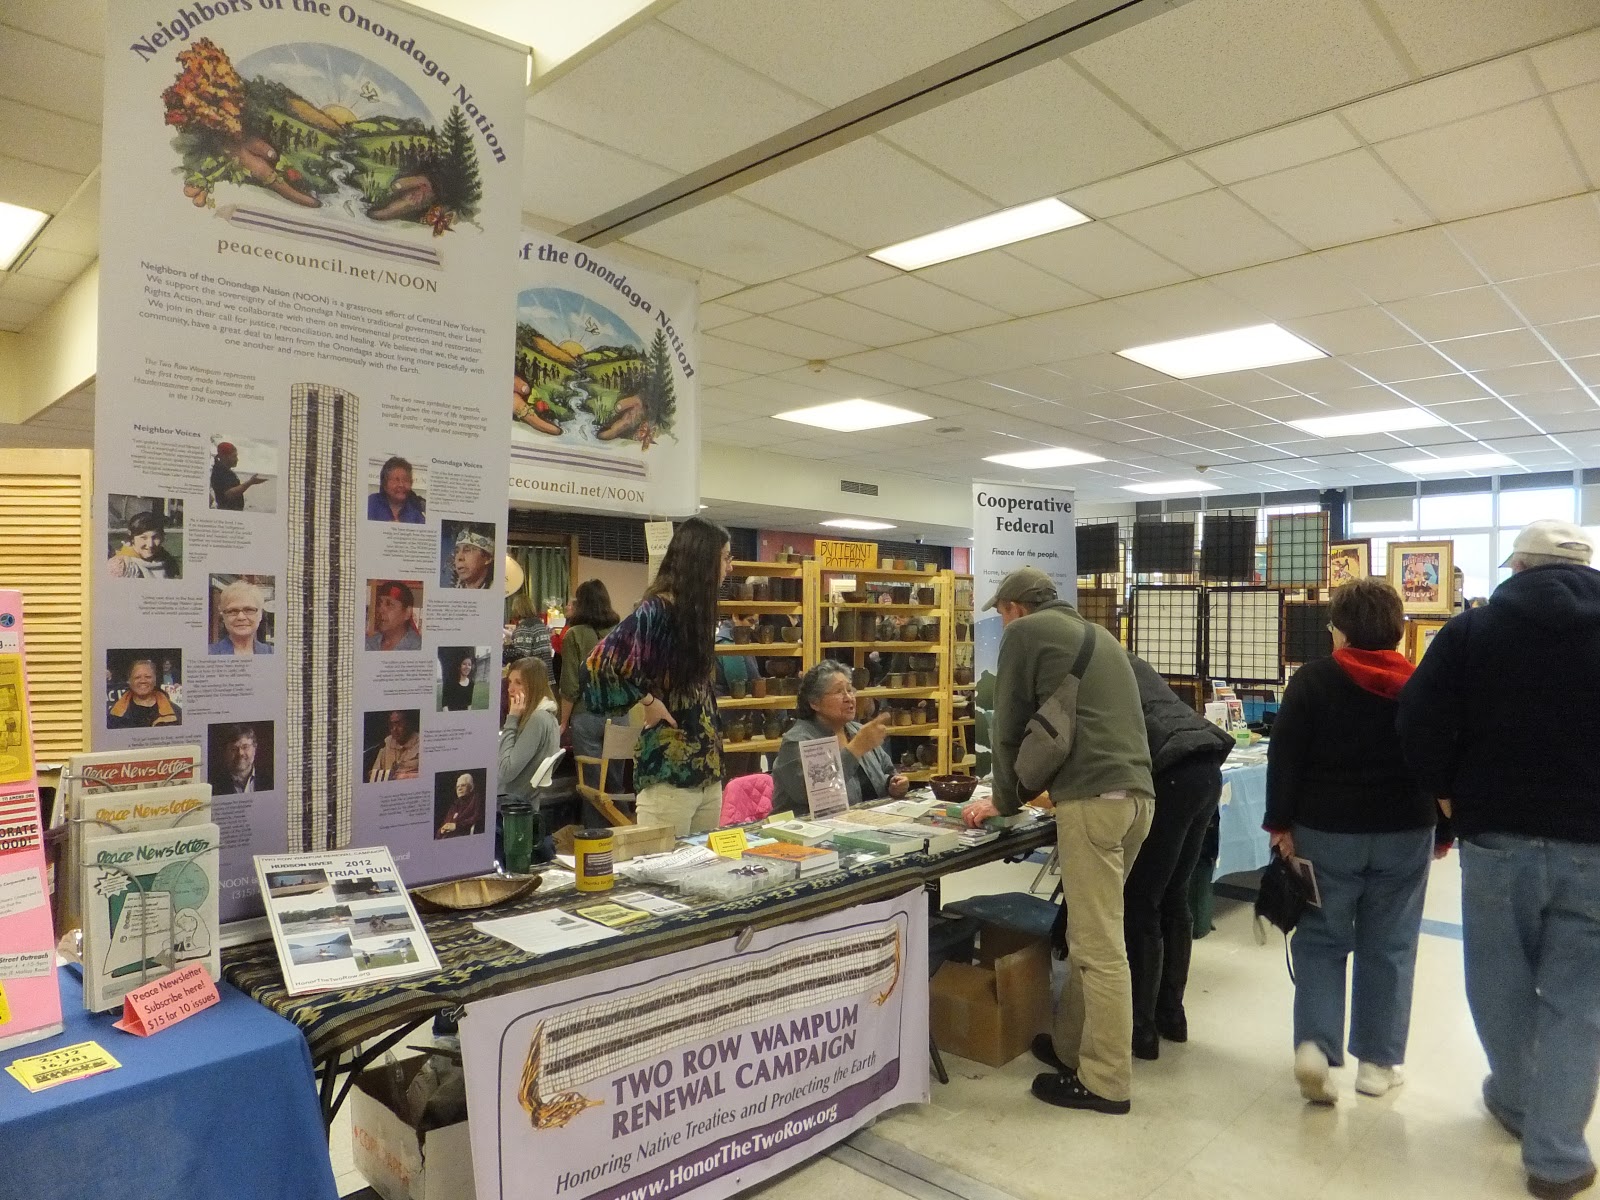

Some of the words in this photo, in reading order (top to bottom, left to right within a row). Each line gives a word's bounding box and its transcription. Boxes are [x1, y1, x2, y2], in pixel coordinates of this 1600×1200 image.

[130, 0, 253, 62] Neighbors
[339, 5, 450, 86] Onondaga
[453, 84, 506, 163] Nation
[217, 239, 437, 293] peacecouncil.net/NOON
[141, 261, 187, 278] Neighbors
[190, 272, 199, 280] of
[201, 275, 215, 284] the
[218, 277, 260, 293] Onondaga
[263, 285, 290, 298] Nation
[292, 291, 330, 305] (NOON)
[346, 302, 383, 316] grassroots
[385, 310, 405, 319] effort
[416, 315, 441, 326] Central
[443, 320, 459, 330] New
[461, 324, 487, 335] Yorkers.
[146, 274, 163, 285] We
[165, 280, 199, 293] support
[201, 286, 216, 295] the
[218, 291, 265, 305] sovereignty
[267, 299, 276, 307] of
[278, 301, 291, 309] the
[293, 303, 333, 318] Onondaga
[336, 310, 365, 322] Nation's
[367, 318, 404, 330] traditional
[405, 325, 447, 338] government,
[448, 331, 464, 340] their
[465, 335, 482, 344] Land
[538, 244, 569, 264] the
[574, 252, 652, 314] Onondaga
[655, 309, 695, 379] Nation
[134, 424, 174, 435] Neighbor
[175, 428, 201, 438] Voices
[431, 457, 463, 468] Onondaga
[463, 461, 483, 469] Voices
[977, 492, 1072, 513] Cooperative
[996, 516, 1055, 535] Federal
[821, 541, 872, 559] BUTTERNUT
[825, 556, 867, 569] POTTERY
[991, 547, 1015, 557] Finance
[1016, 549, 1026, 557] for
[1027, 549, 1036, 557] the
[1037, 551, 1059, 560] people.
[83, 765, 118, 786] Peace
[120, 760, 192, 779] Newsletter
[96, 808, 130, 828] Peace
[133, 798, 204, 819] Newsletter
[0, 837, 32, 850] OOD!
[97, 850, 134, 871] Peace
[136, 839, 210, 861] Newsletter
[271, 862, 307, 870] HUDSON
[308, 860, 334, 868] RIVER
[345, 859, 373, 868] 2012
[326, 868, 364, 879] TRIAL
[366, 866, 393, 875] RUN
[132, 986, 159, 1003] Peace
[158, 967, 202, 992] Newsletter
[144, 993, 183, 1014] Subscribe
[183, 980, 206, 997] here!
[147, 1015, 165, 1030] $15
[165, 1011, 178, 1022] for
[179, 1003, 191, 1015] 10
[190, 993, 216, 1009] issues
[611, 1059, 674, 1106] TWO
[682, 1034, 743, 1078] ROW
[750, 1003, 860, 1054] WAMPUM
[611, 1071, 727, 1140] RENEWAL
[735, 1029, 858, 1089] CAMPAIGN
[555, 1151, 632, 1194] Honoring
[636, 1130, 681, 1163] Native
[686, 1108, 737, 1137] Treaties
[740, 1099, 768, 1119] and
[770, 1077, 831, 1111] Protecting
[833, 1064, 849, 1083] the
[850, 1050, 877, 1075] Earth
